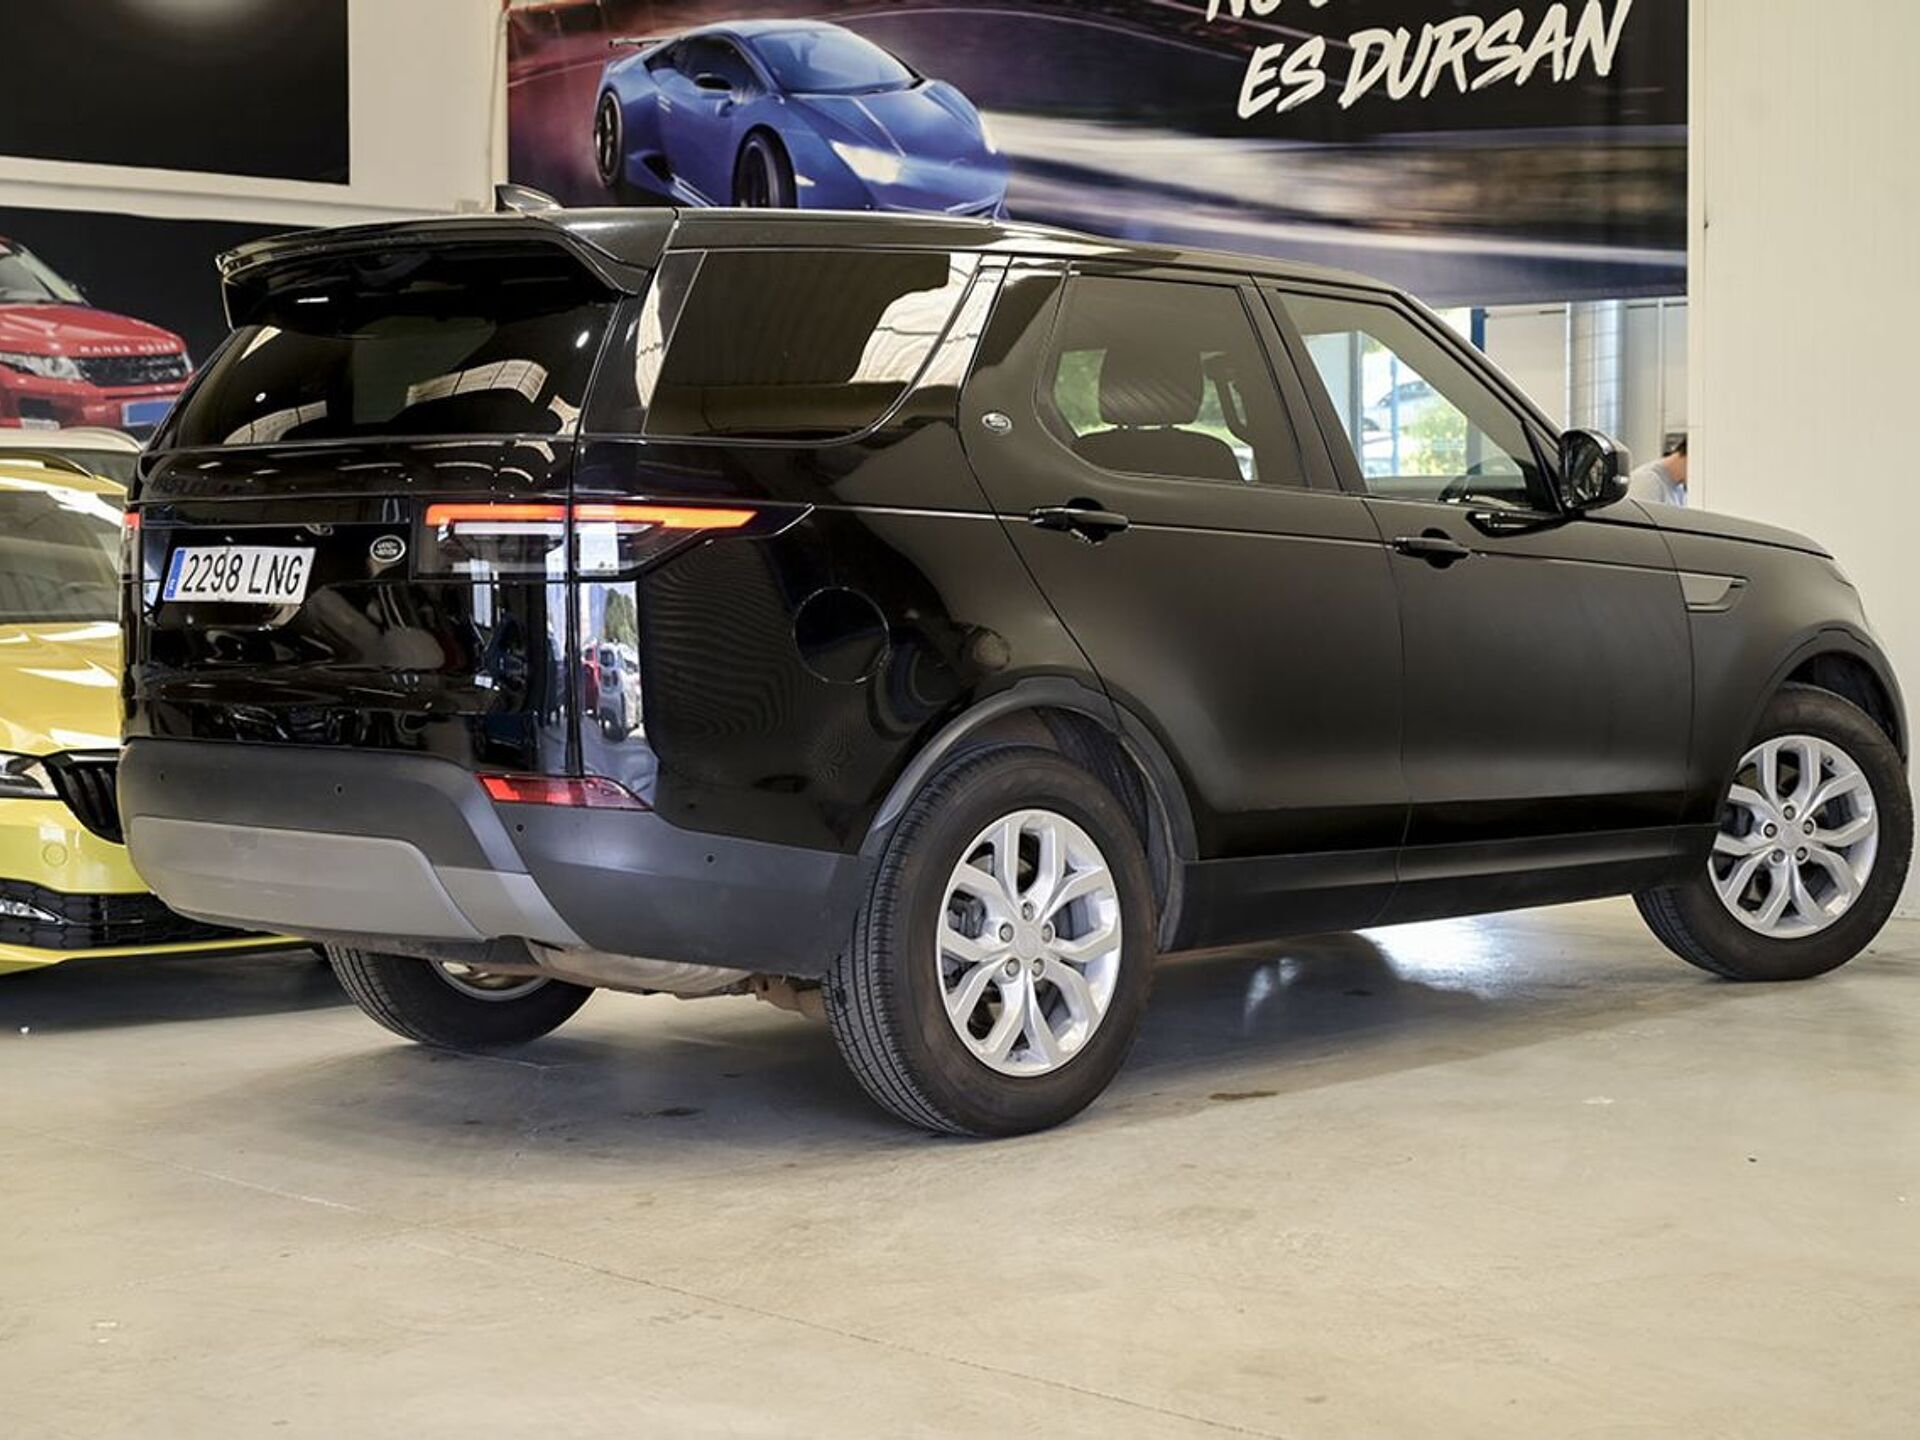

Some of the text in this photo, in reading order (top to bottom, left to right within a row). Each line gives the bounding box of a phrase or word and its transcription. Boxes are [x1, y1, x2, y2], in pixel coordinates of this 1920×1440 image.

[1237, 0, 1632, 119] ES DURSAN
[181, 553, 303, 595] 2298 LNG
